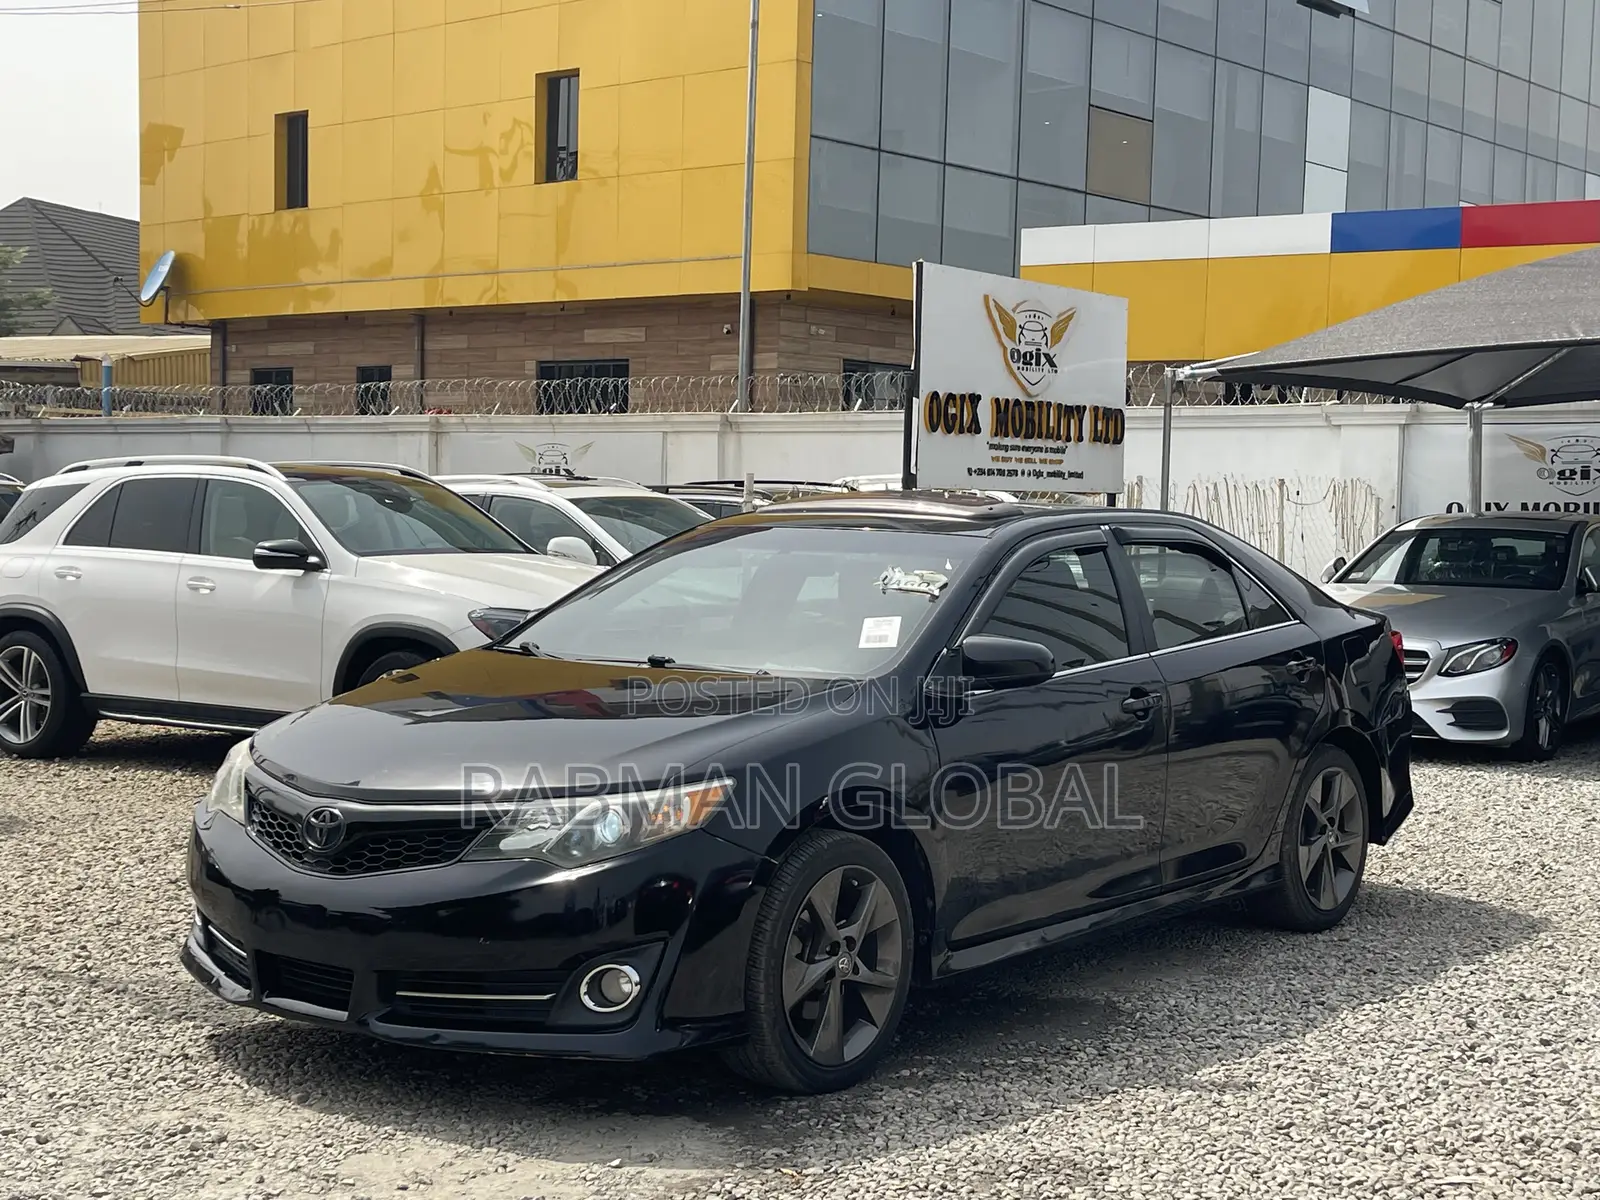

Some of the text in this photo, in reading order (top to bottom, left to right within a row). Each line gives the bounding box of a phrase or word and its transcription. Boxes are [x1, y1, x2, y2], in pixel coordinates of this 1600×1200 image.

[924, 390, 1125, 445] OGIX MOBILITY LTD
[1446, 501, 1509, 514] OIX
